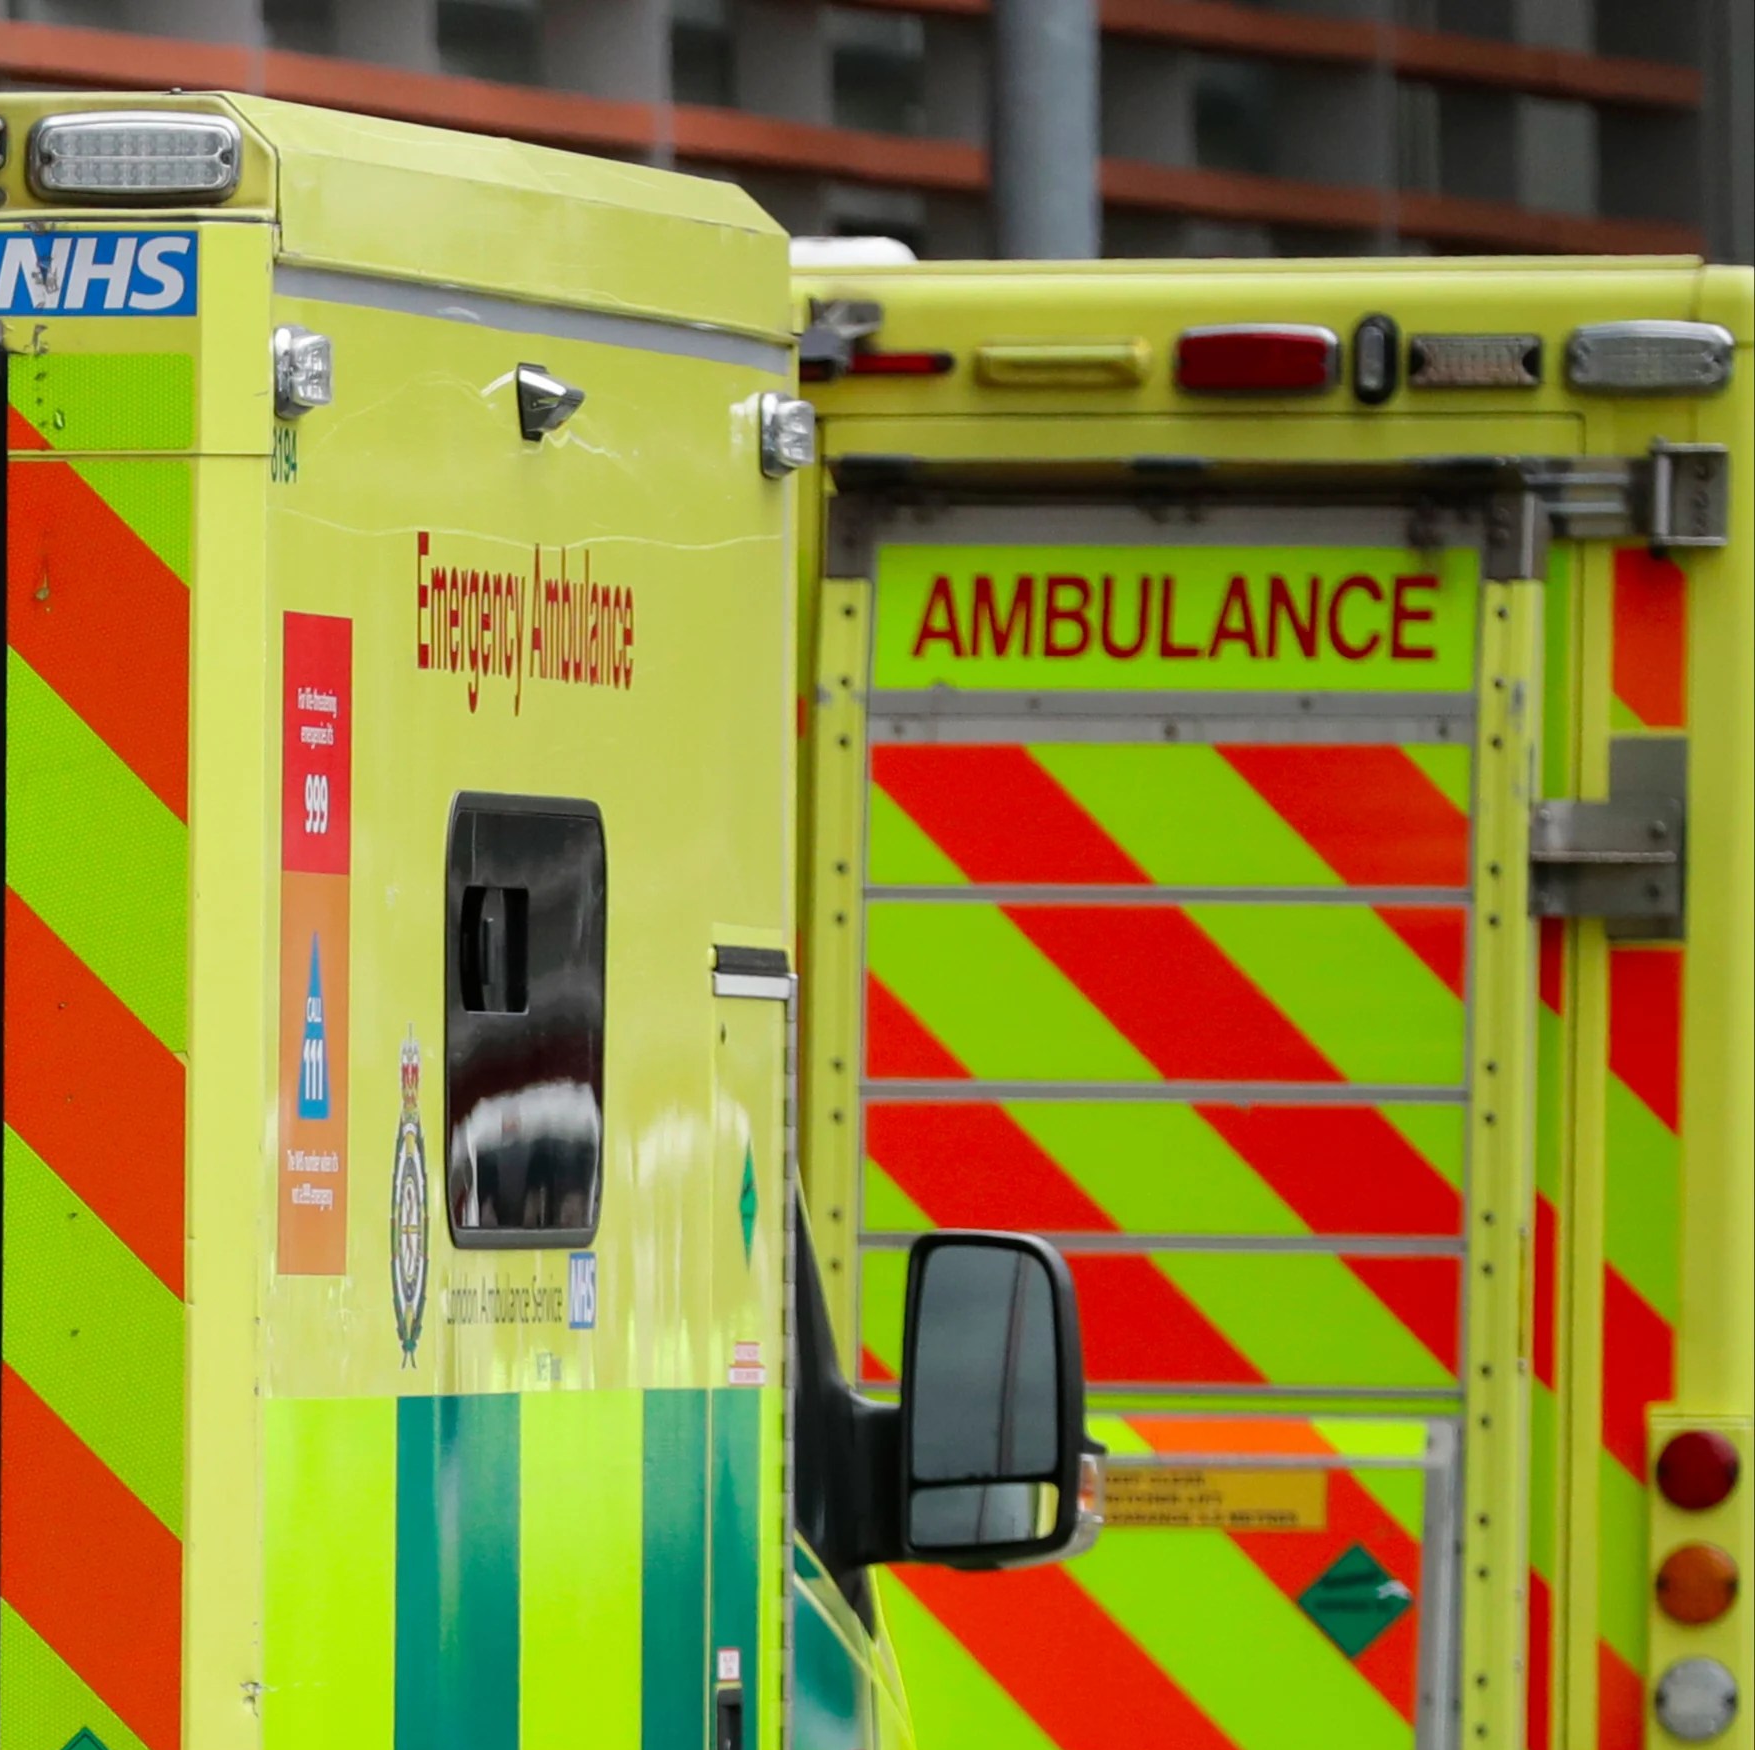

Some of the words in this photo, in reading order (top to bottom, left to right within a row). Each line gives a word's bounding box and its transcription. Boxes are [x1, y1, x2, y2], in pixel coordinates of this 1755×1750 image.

[271, 426, 297, 485] 8194
[416, 531, 525, 716] Emergency
[530, 543, 635, 691] Ambulance
[912, 573, 1439, 661] AMBULANCE
[304, 773, 329, 834] 999
[306, 996, 322, 1023] CALL
[303, 1038, 323, 1100] 111
[480, 1274, 530, 1325] Ambulance
[531, 1272, 564, 1323] Service
